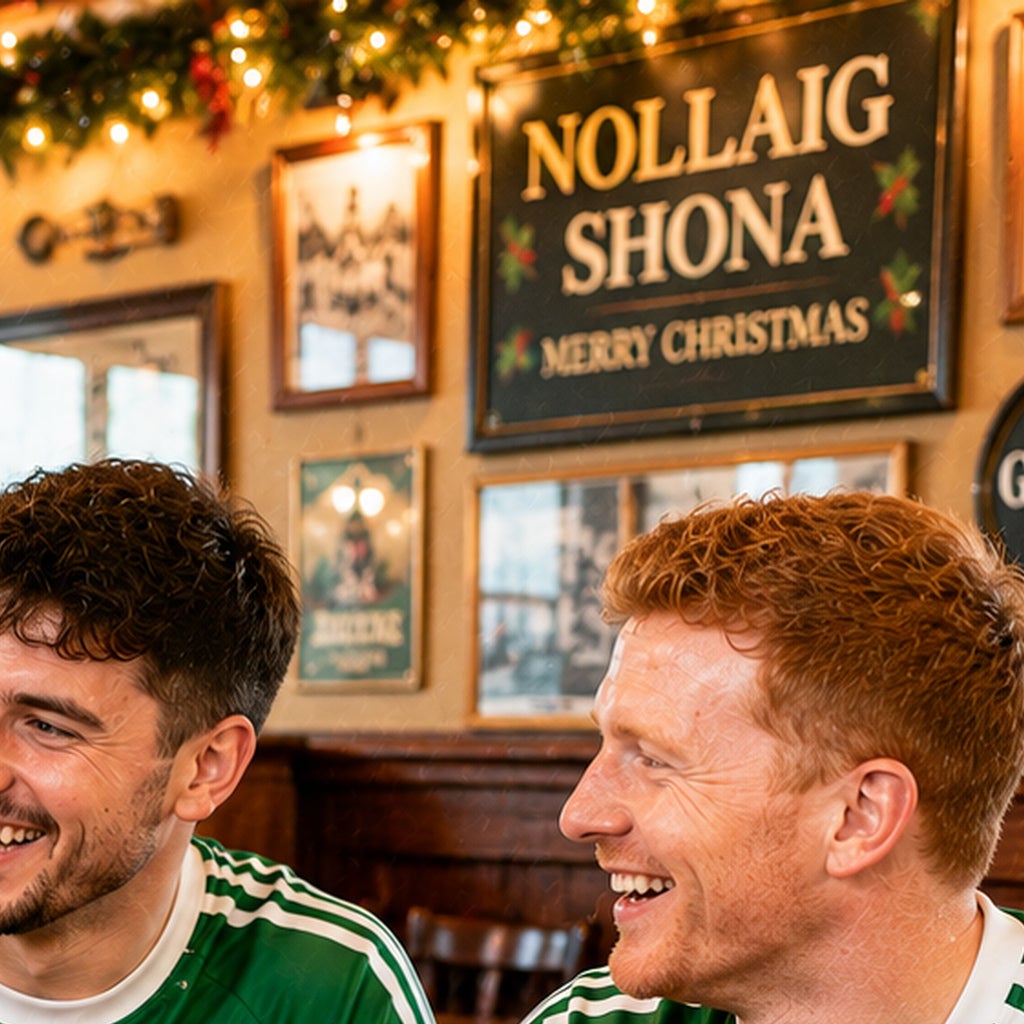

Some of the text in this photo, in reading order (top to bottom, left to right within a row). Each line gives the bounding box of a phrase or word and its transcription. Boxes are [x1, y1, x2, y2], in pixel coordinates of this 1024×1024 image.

[521, 53, 894, 201] NOLLAIG
[562, 173, 850, 295] SHONA
[540, 298, 869, 379] MERRY CHRISTMAS
